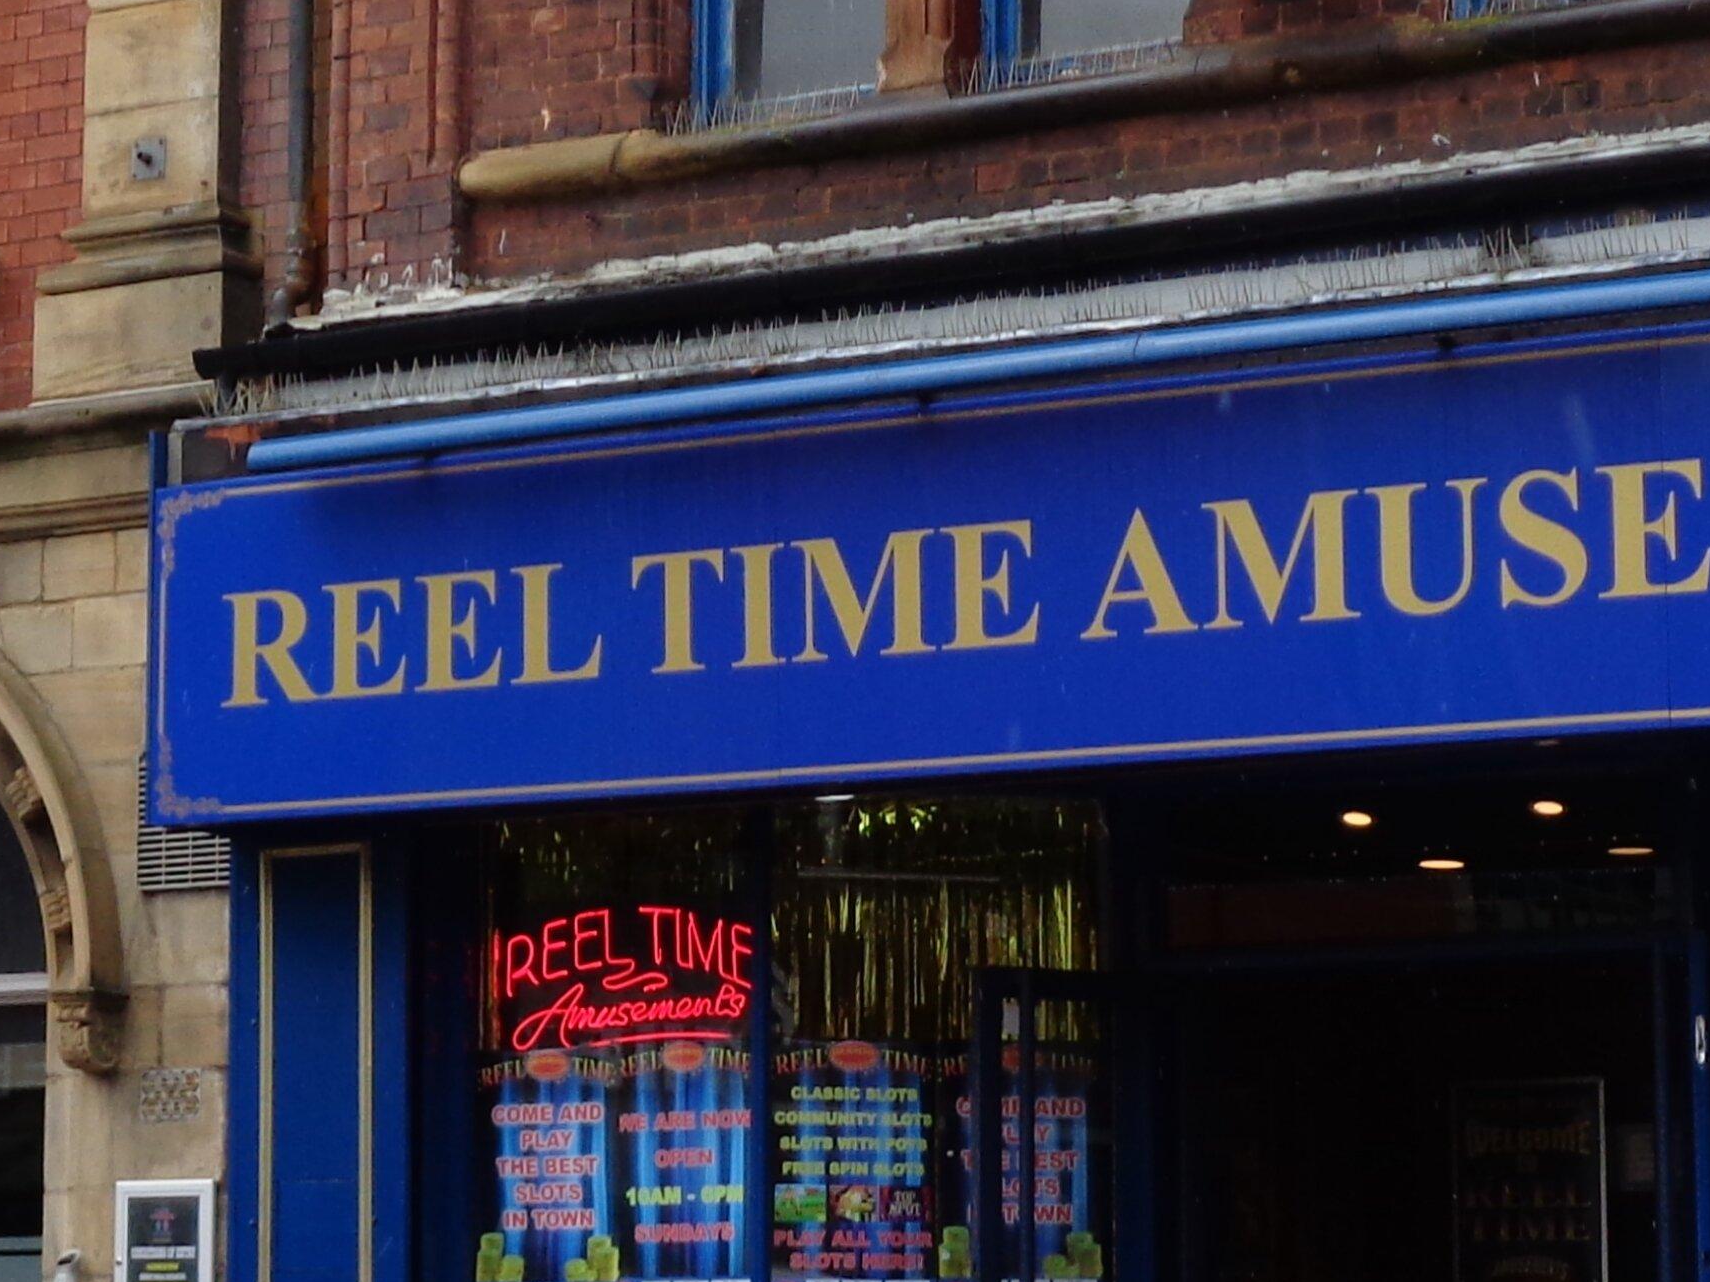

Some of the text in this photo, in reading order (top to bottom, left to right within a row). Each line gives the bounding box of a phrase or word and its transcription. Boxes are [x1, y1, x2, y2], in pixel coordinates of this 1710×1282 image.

[220, 562, 603, 709] REEL
[631, 518, 1041, 675] TIME
[505, 905, 753, 998] REEL TIME
[511, 983, 747, 1051] Amusements
[790, 1085, 920, 1103] CLASSIC SLOTS
[492, 1101, 605, 1126] COME AND
[701, 1108, 752, 1129] NOW
[773, 1110, 877, 1127] COMMUNITY
[520, 1129, 573, 1151] PLAY
[495, 1155, 599, 1178] THE BEST
[514, 1182, 583, 1204] SLOTS
[503, 1208, 596, 1230] IN TOWN
